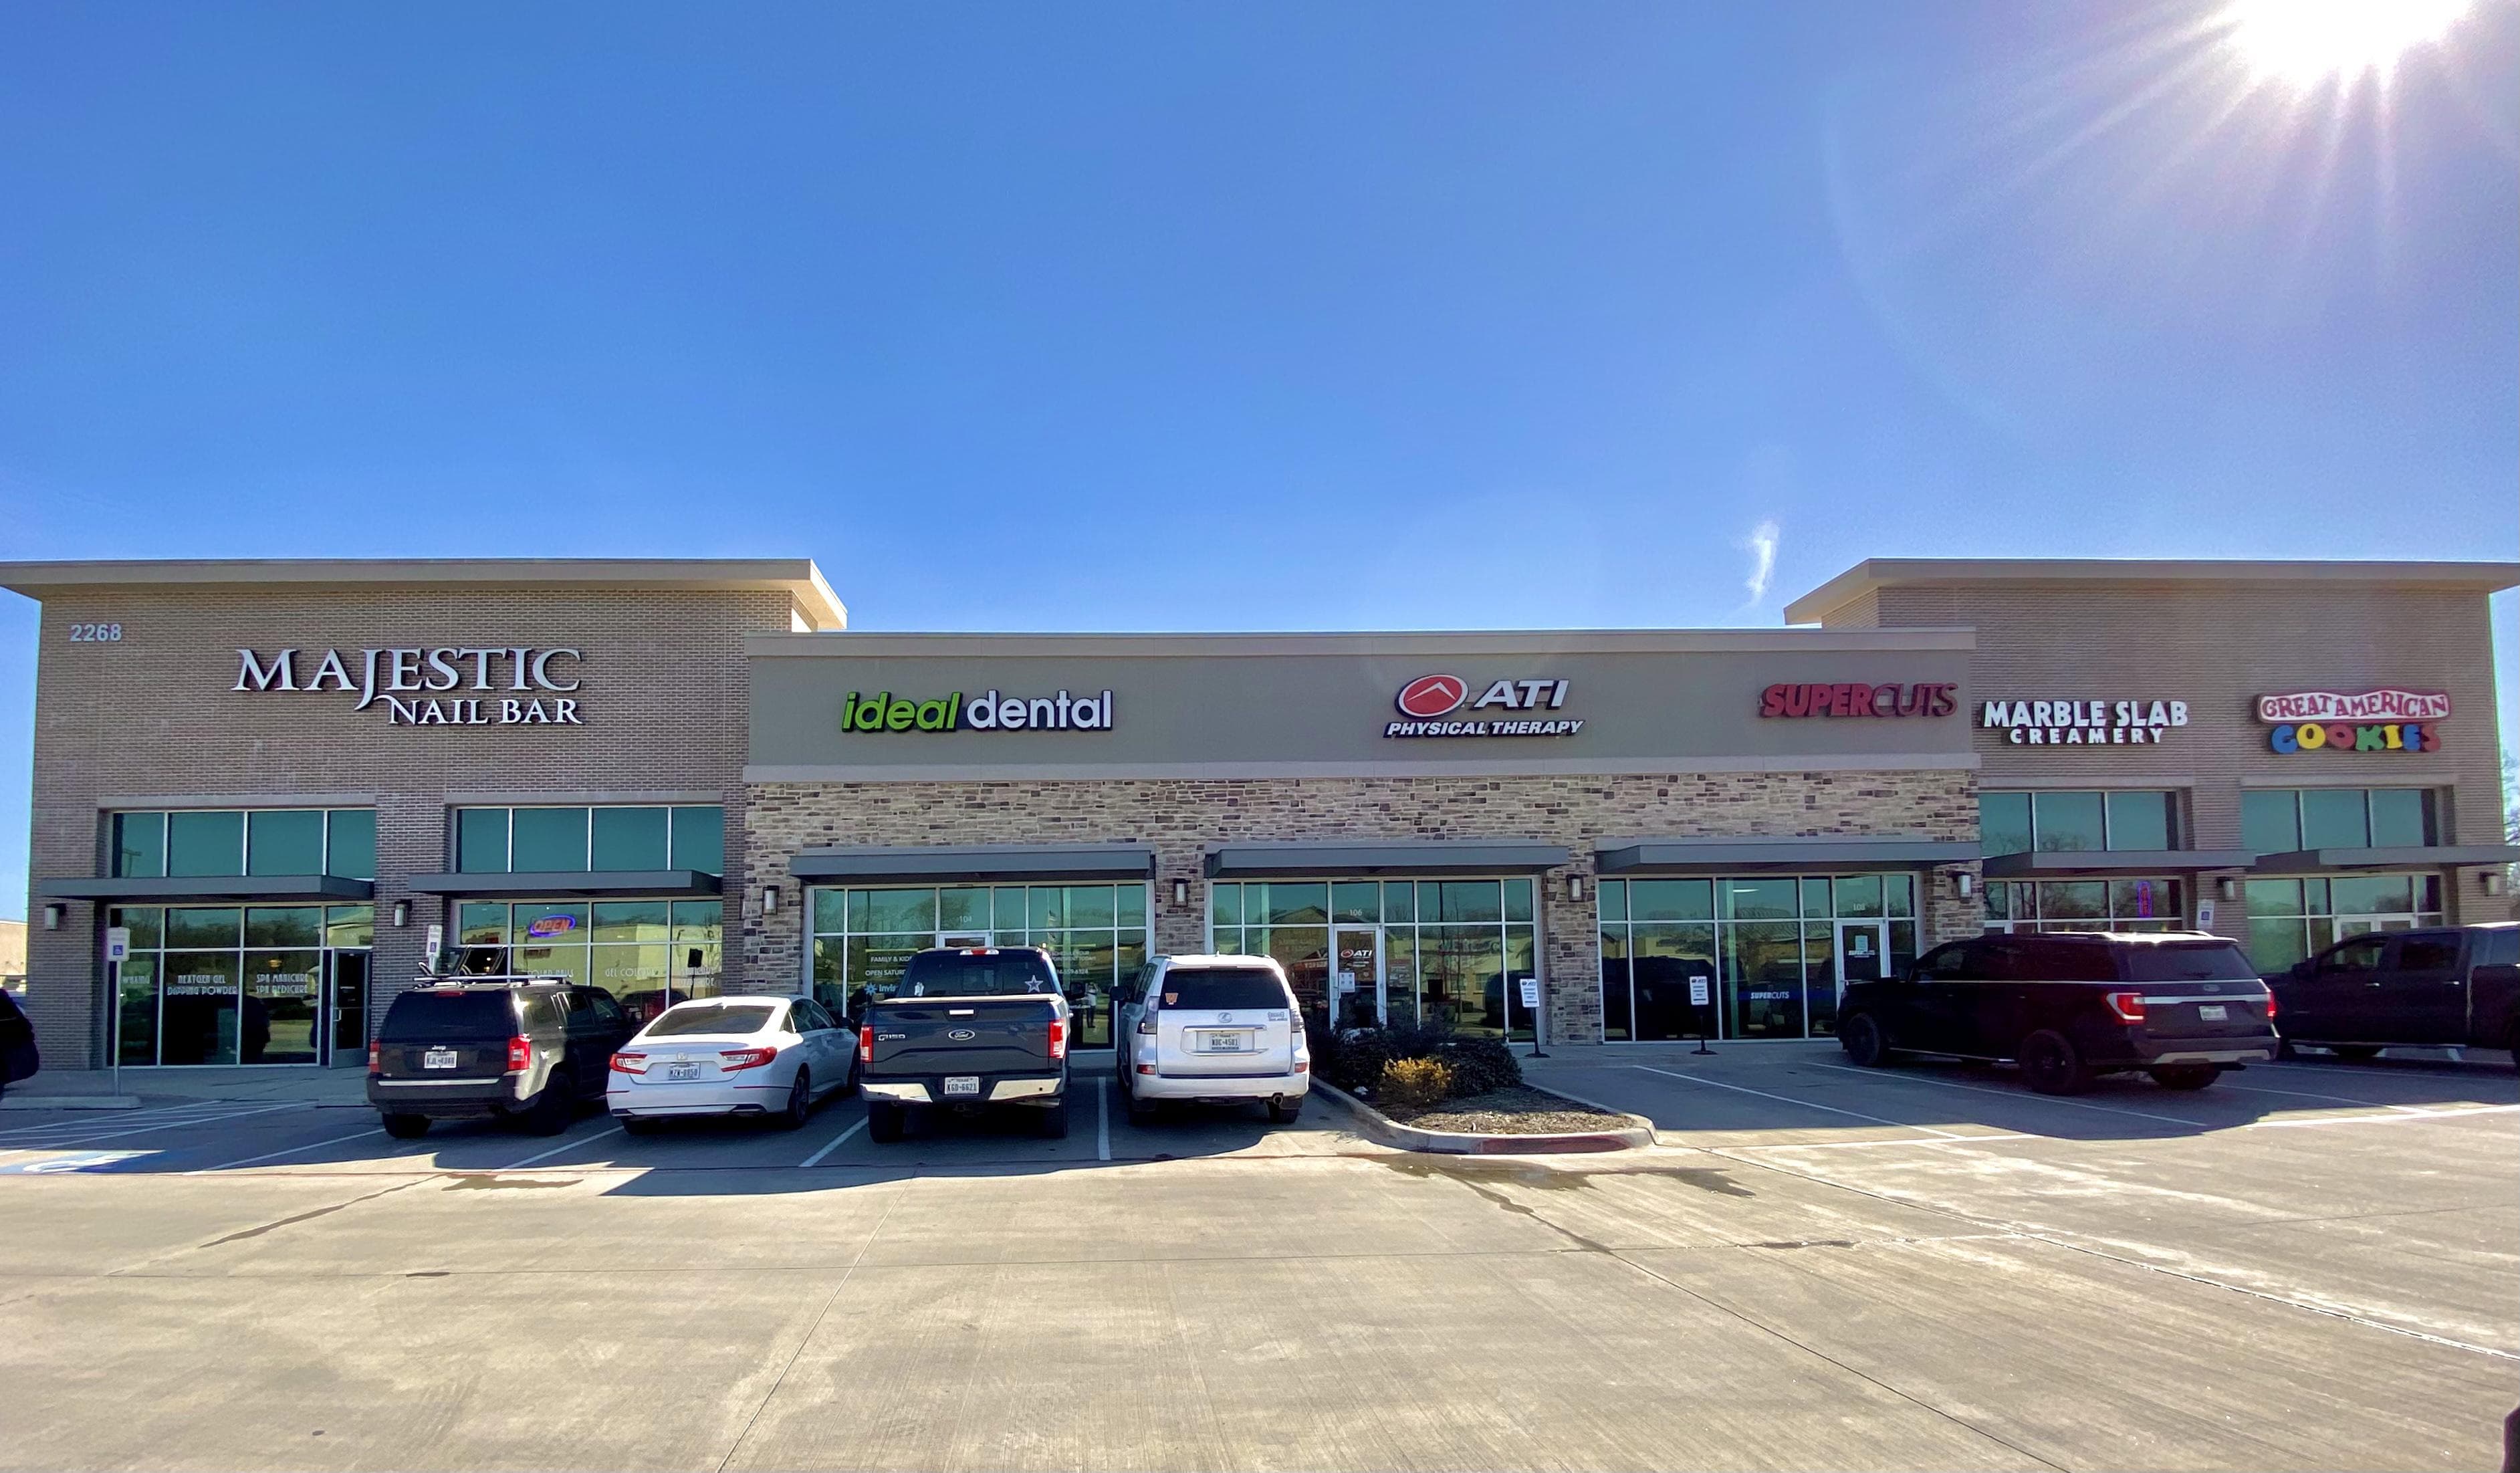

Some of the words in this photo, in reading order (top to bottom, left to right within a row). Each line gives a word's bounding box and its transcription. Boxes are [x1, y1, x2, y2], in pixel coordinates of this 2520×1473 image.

[70, 623, 122, 642] 2268
[230, 647, 584, 711] MAJESTIC
[1472, 679, 1569, 709] ATI
[1760, 682, 1959, 717] SUPERCUTS
[374, 694, 490, 726] NAIL
[499, 697, 584, 725] BAR
[842, 691, 963, 731] ideal
[967, 689, 1112, 730] dental
[2261, 695, 2332, 717] GREAT
[2334, 691, 2448, 717] AMERICAN
[1983, 700, 2107, 728] MARBLE
[2114, 700, 2188, 727] SLAB
[1385, 721, 1490, 737] PHYSICAL
[1490, 720, 1585, 736] THERAPY
[2009, 727, 2164, 745] CREAMERY
[2271, 723, 2442, 754] COOKIES
[534, 918, 571, 933] OPEN
[213, 975, 226, 984] GEL
[256, 974, 270, 983] SPA
[272, 974, 309, 983] MANICURE
[201, 986, 239, 995] POWDER
[256, 985, 270, 994] SPA
[271, 985, 308, 994] PEDICURE
[1750, 992, 1790, 1000] SUPERCUTS
